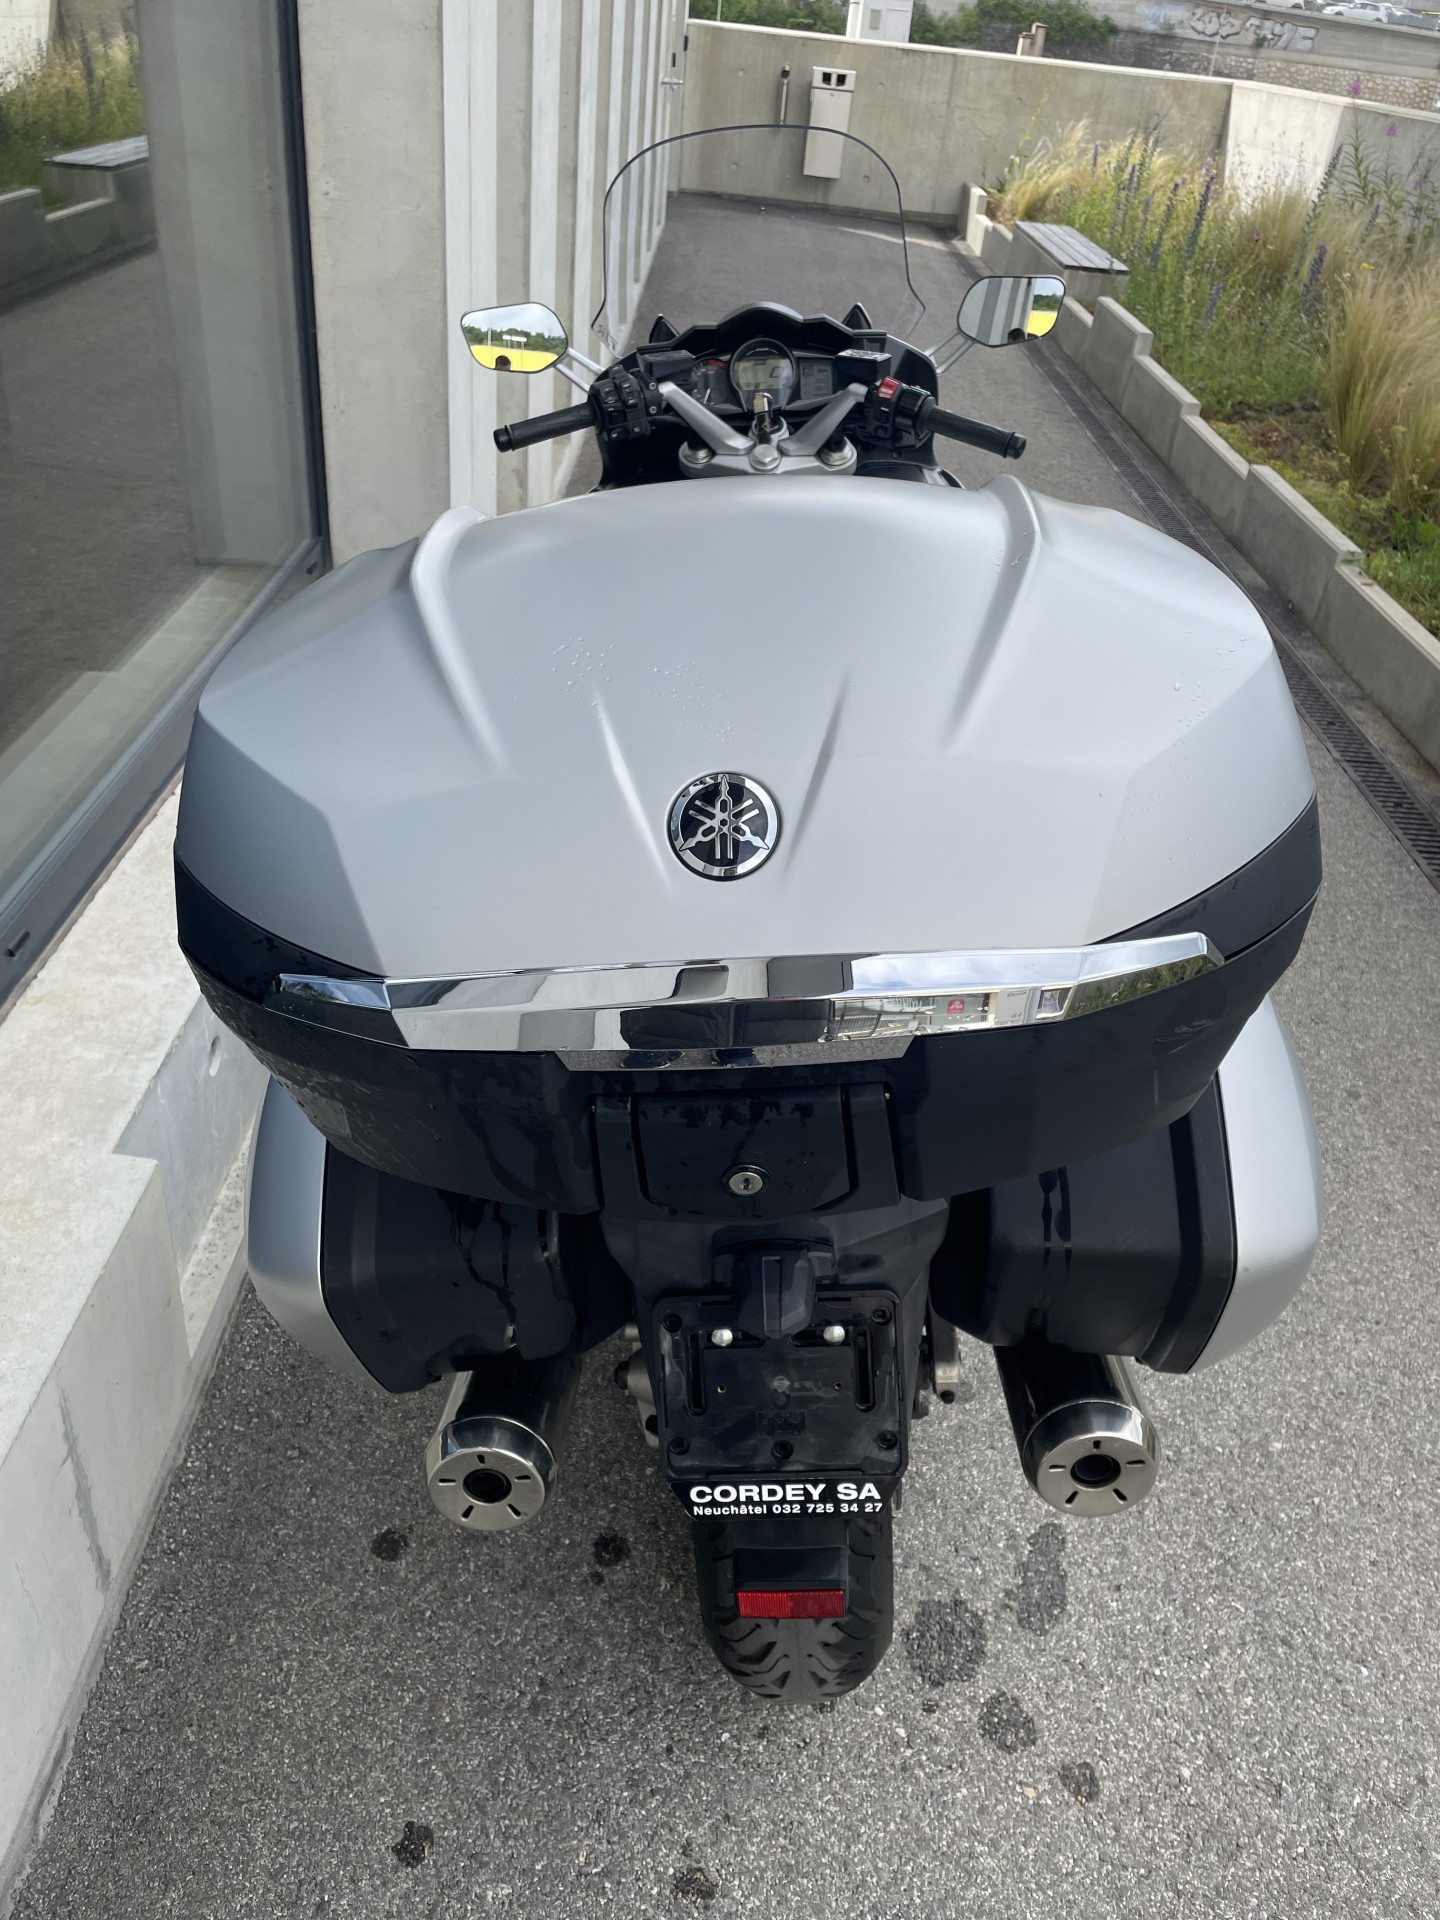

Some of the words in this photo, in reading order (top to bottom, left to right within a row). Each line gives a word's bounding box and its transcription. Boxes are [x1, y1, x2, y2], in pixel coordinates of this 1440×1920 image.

[689, 1483, 827, 1503] CORDEY
[836, 1482, 882, 1501] SA
[693, 1504, 767, 1516] Neuchâtel
[772, 1503, 801, 1514] 032
[806, 1503, 835, 1513] 725
[840, 1503, 859, 1513] 34
[863, 1502, 883, 1513] 27
